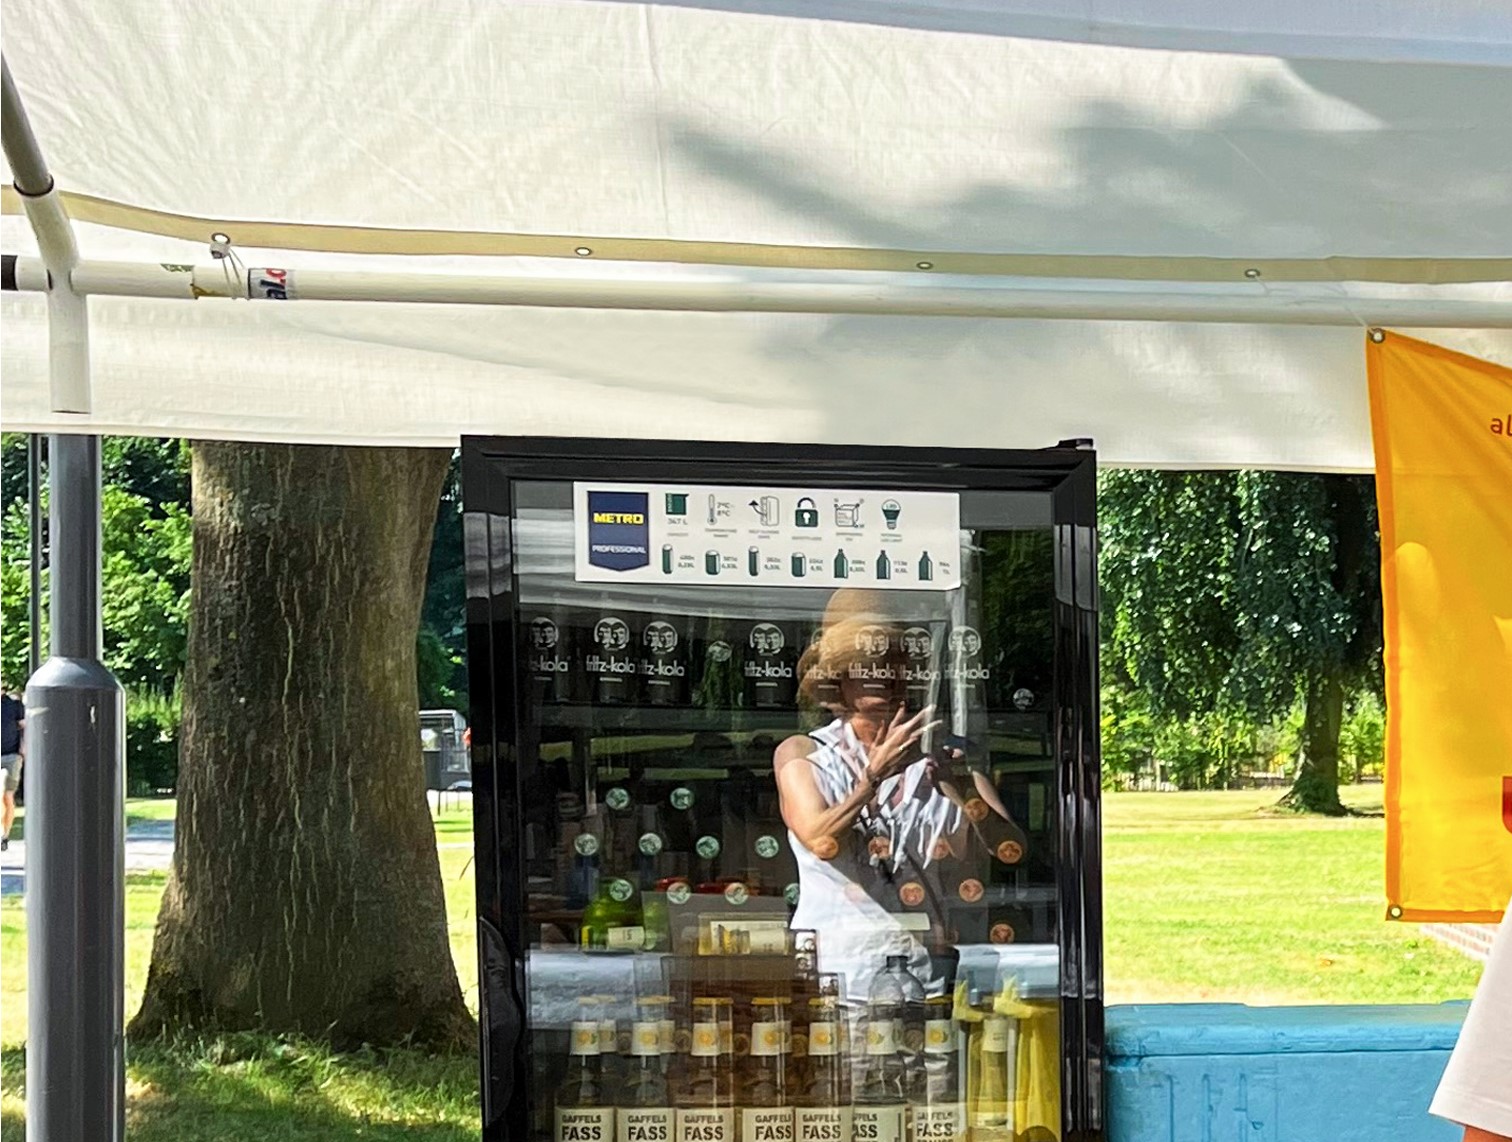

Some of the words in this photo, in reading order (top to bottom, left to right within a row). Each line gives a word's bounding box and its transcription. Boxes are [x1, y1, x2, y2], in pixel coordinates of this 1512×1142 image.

[593, 512, 644, 524] METRO
[592, 544, 646, 554] PROFESSIONAL
[562, 1115, 601, 1123] GAFFELS
[628, 1115, 667, 1123] GAFFELS
[684, 1115, 723, 1123] GAFFELS
[562, 1126, 601, 1140] FASS
[628, 1126, 667, 1140] FASS
[684, 1126, 723, 1140] FASS
[755, 1125, 792, 1140] FASS
[803, 1125, 841, 1139] FASS
[916, 1123, 954, 1137] FASS
